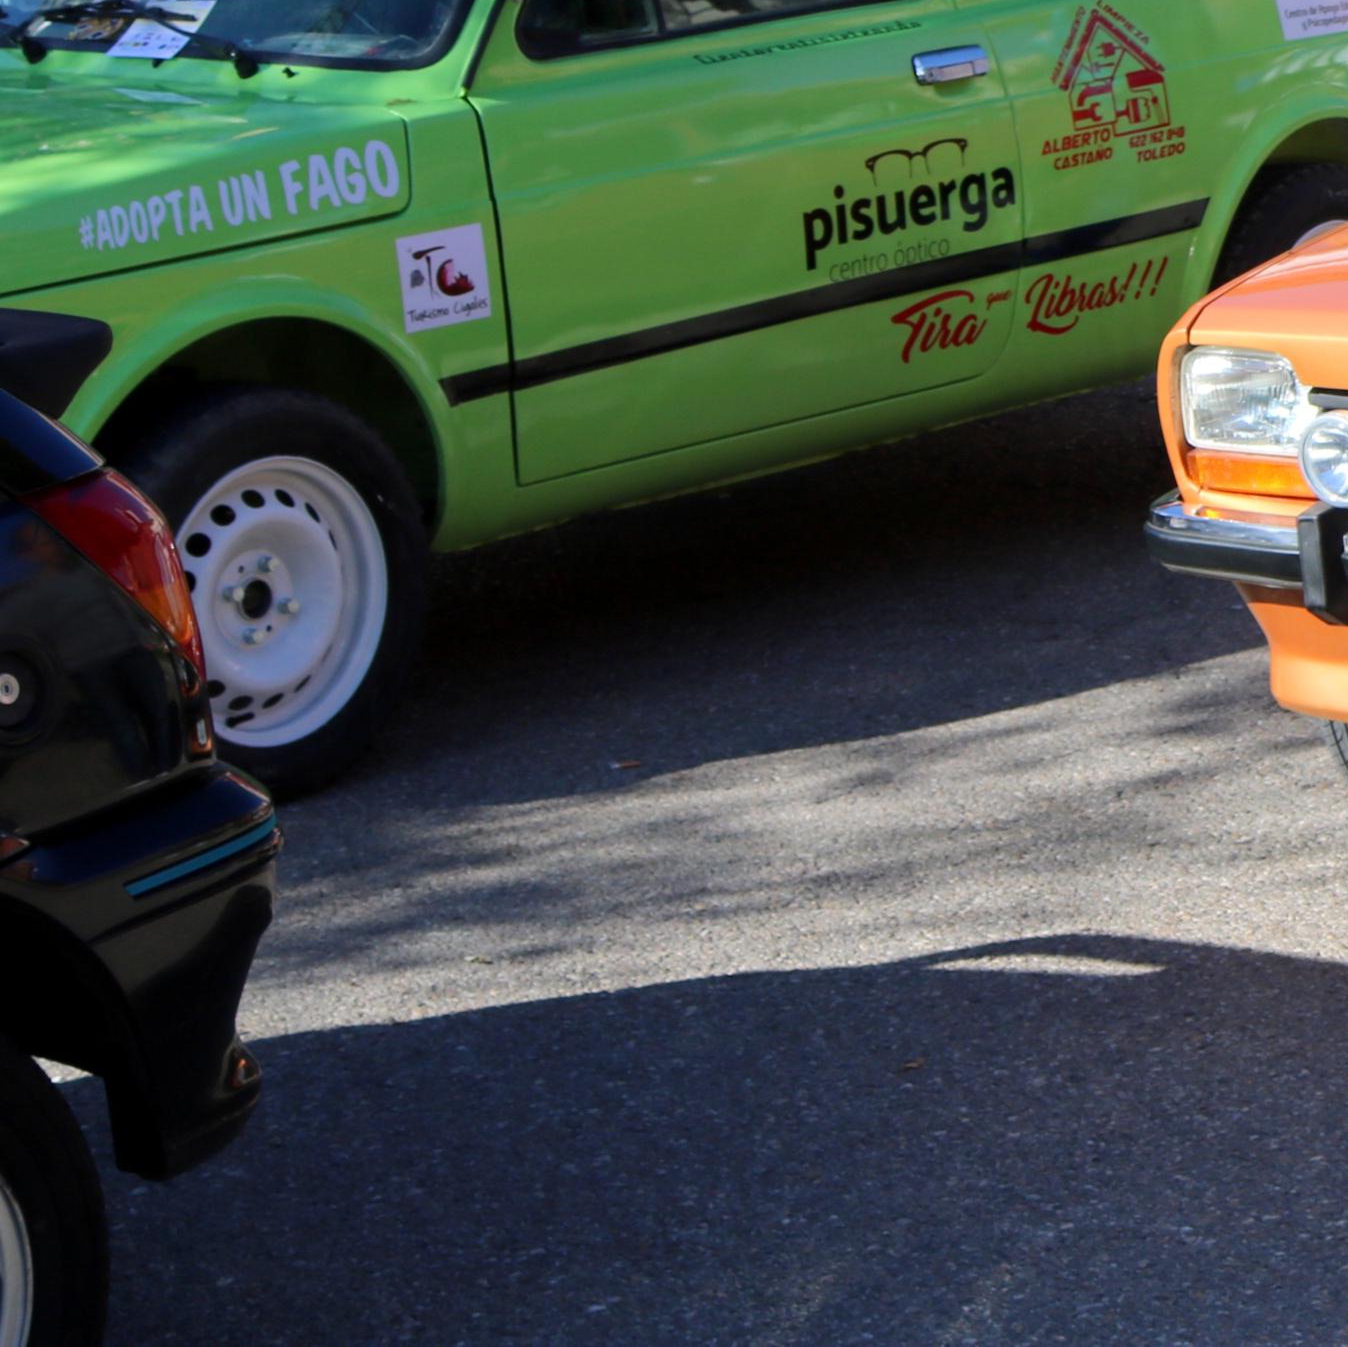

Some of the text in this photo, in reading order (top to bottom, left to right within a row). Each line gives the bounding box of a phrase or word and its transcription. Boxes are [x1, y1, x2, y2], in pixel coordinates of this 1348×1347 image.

[1041, 128, 1111, 156] ALBERTO
[1136, 142, 1186, 163] TOLEDO
[79, 140, 400, 251] #ADOPTA UN FAGO
[802, 166, 1017, 271] pisuerga
[828, 250, 889, 284] centro
[891, 289, 991, 364] Tira
